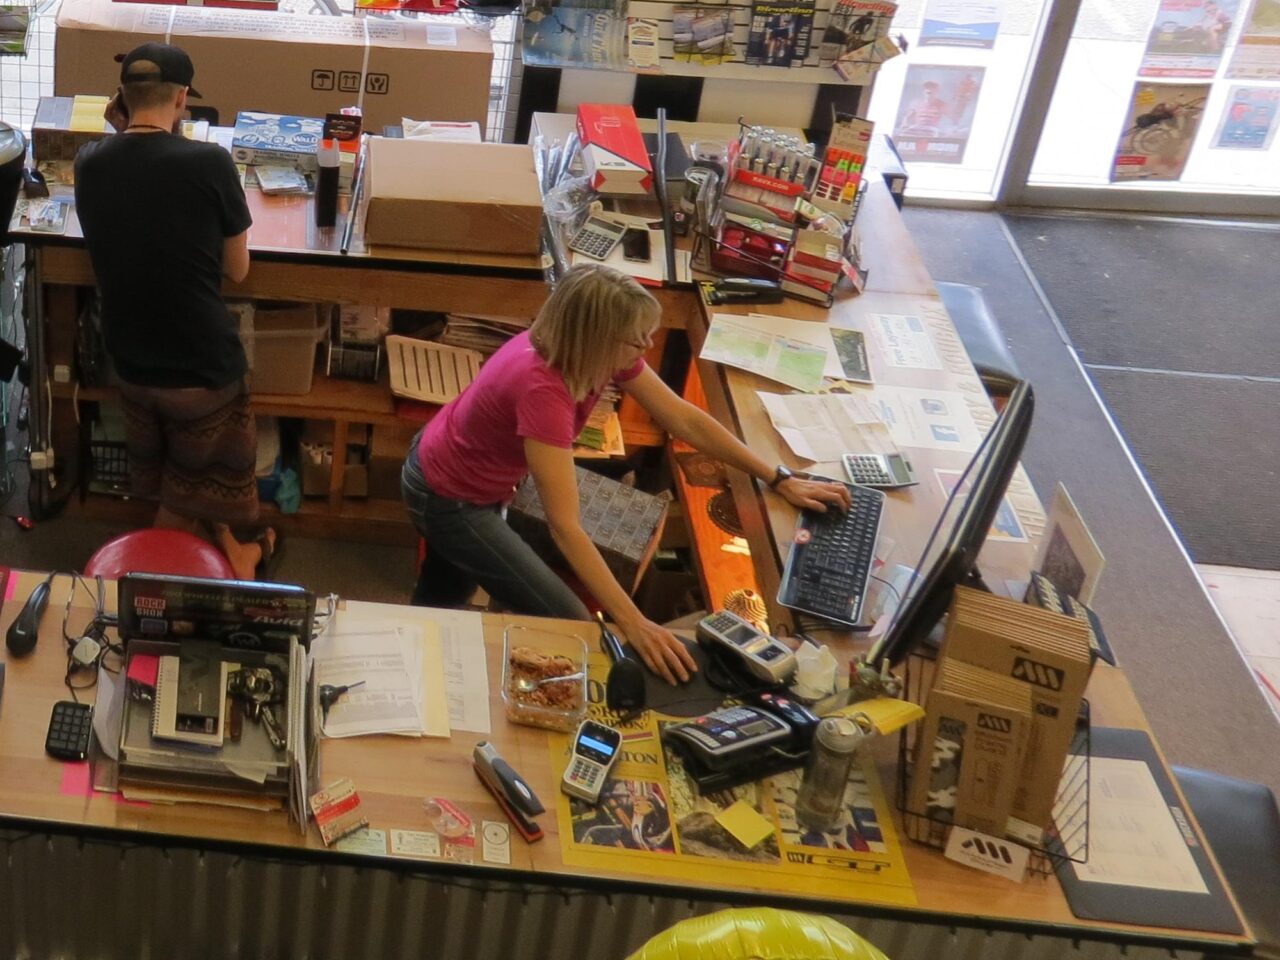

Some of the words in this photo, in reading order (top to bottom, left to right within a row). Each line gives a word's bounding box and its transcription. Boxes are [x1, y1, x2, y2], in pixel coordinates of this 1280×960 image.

[292, 134, 318, 143] WALD
[135, 597, 166, 609] ROCK
[251, 615, 304, 626] Avid
